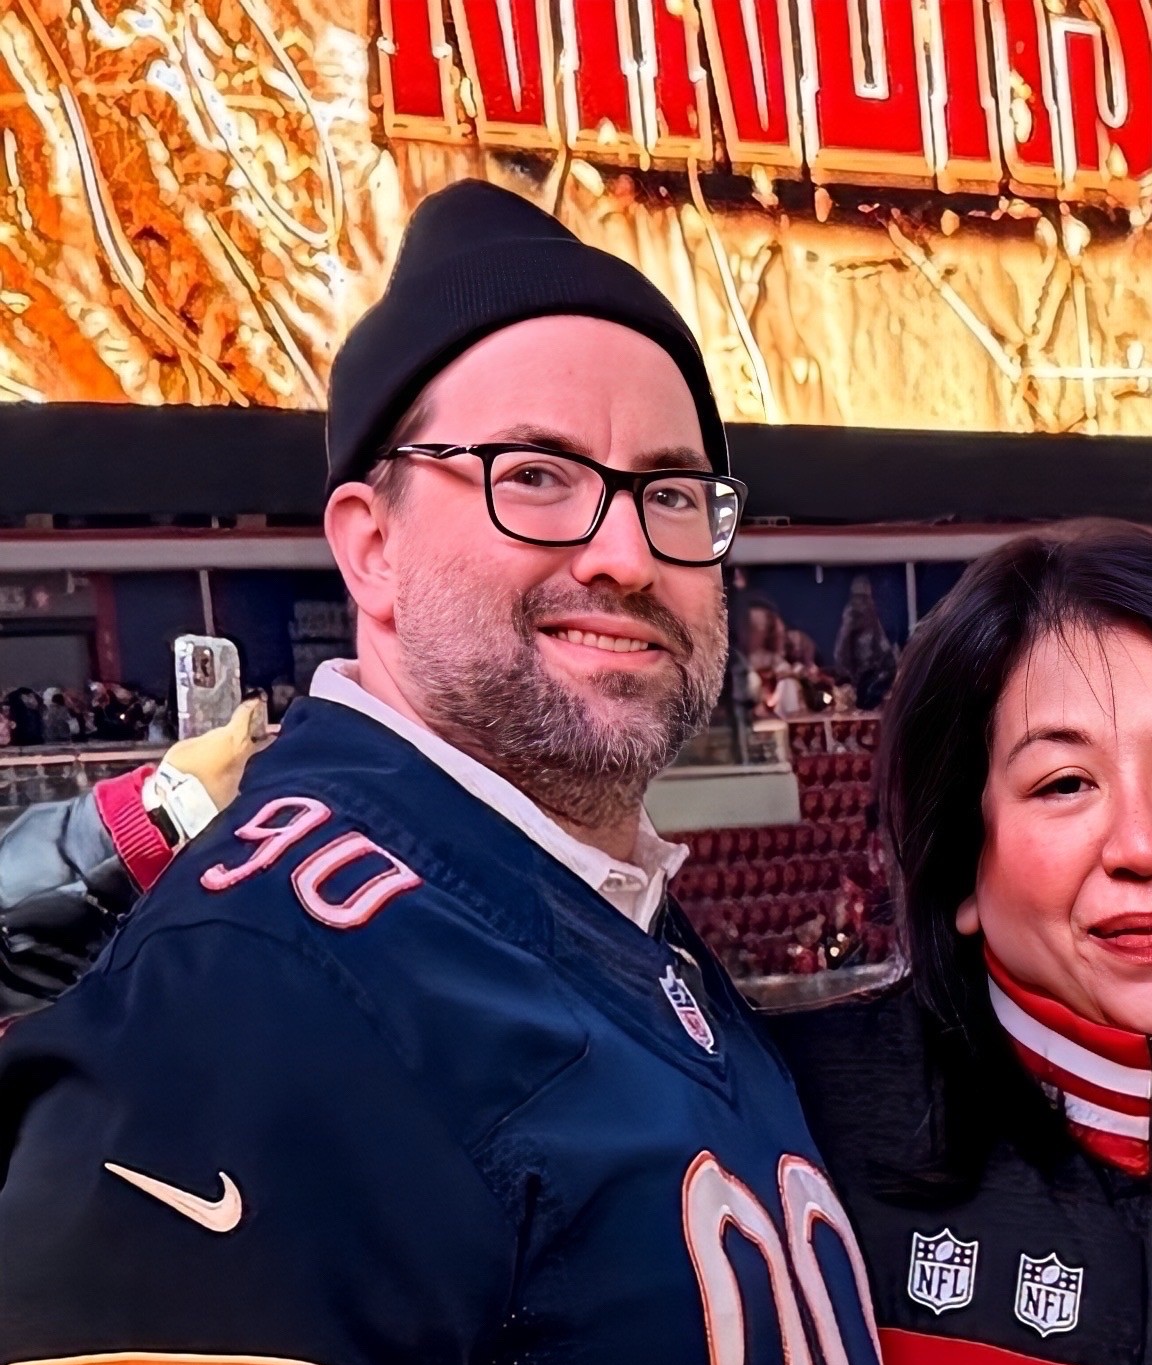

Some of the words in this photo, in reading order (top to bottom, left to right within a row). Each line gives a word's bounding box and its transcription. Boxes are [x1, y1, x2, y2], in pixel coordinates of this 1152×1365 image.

[199, 796, 424, 930] 90
[916, 1264, 965, 1301] NFL
[1024, 1286, 1071, 1324] NFL
